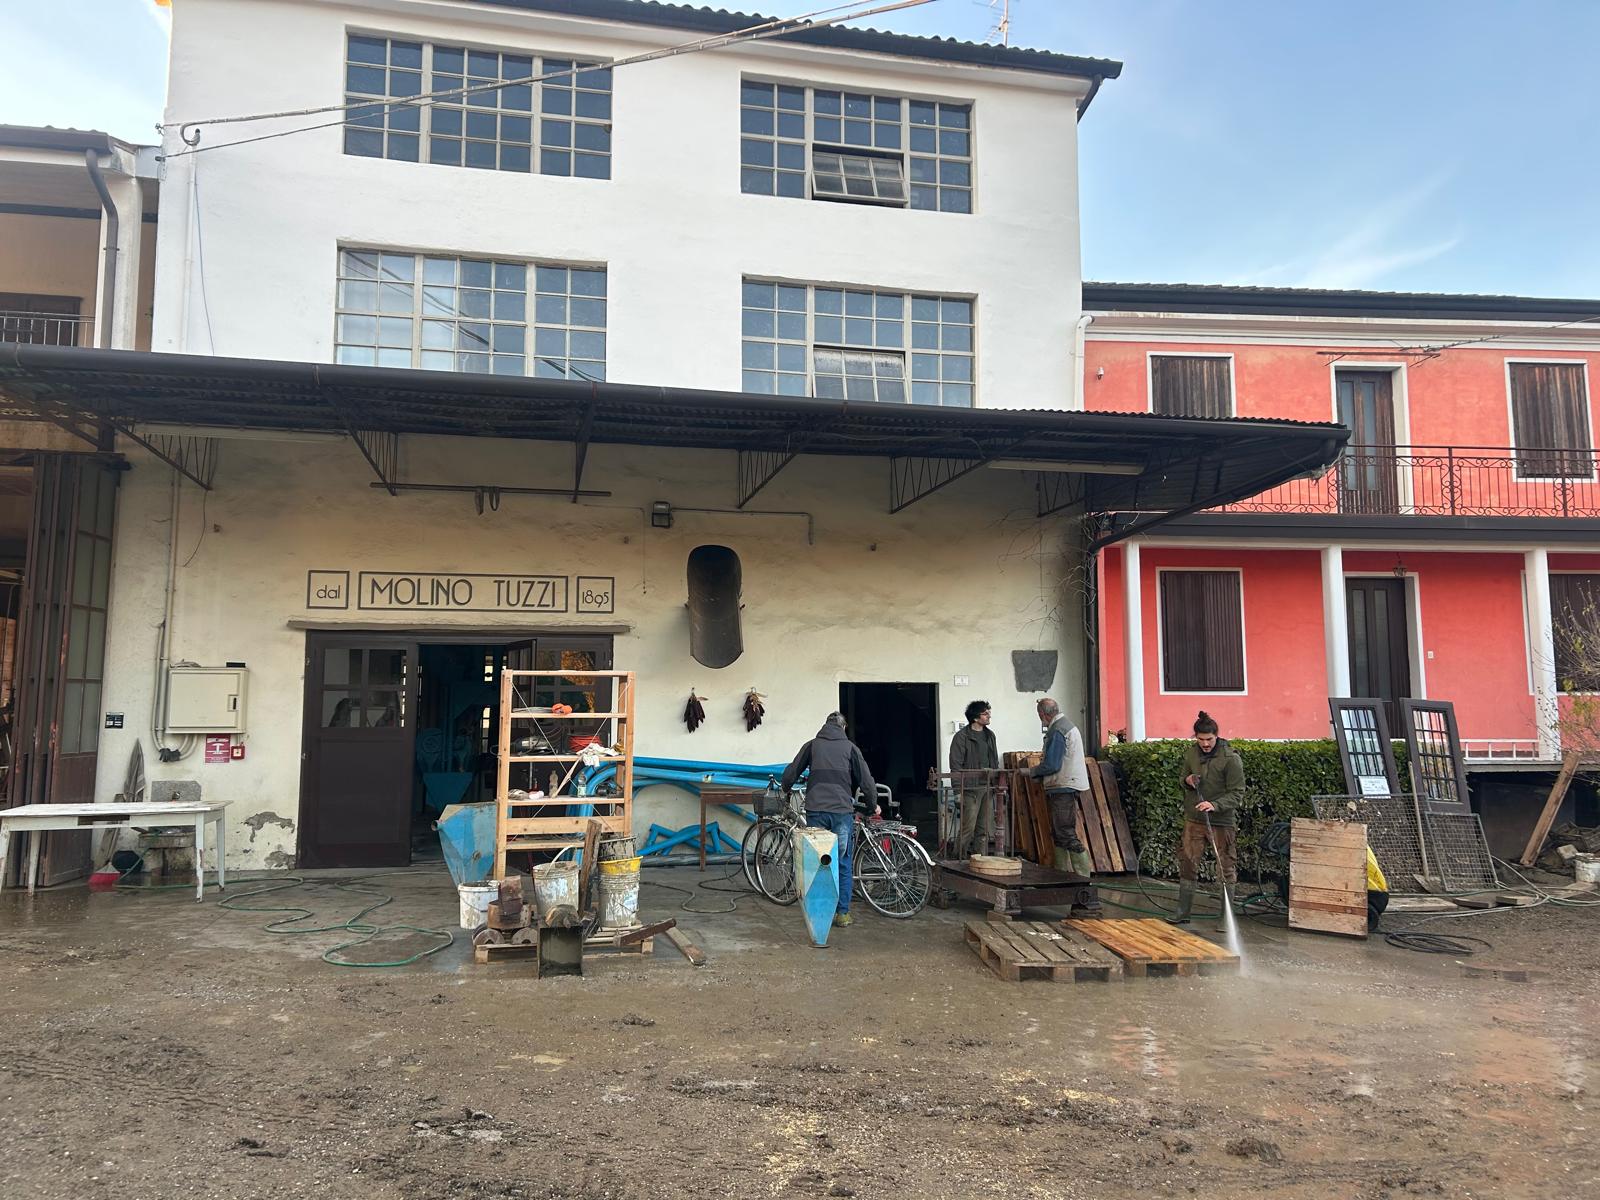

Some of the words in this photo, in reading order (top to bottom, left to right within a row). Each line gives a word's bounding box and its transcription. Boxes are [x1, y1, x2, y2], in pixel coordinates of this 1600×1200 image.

[316, 585, 341, 600] dal
[370, 577, 473, 606] MOLINO
[493, 579, 557, 608] TUZZI
[581, 590, 610, 608] 1895
